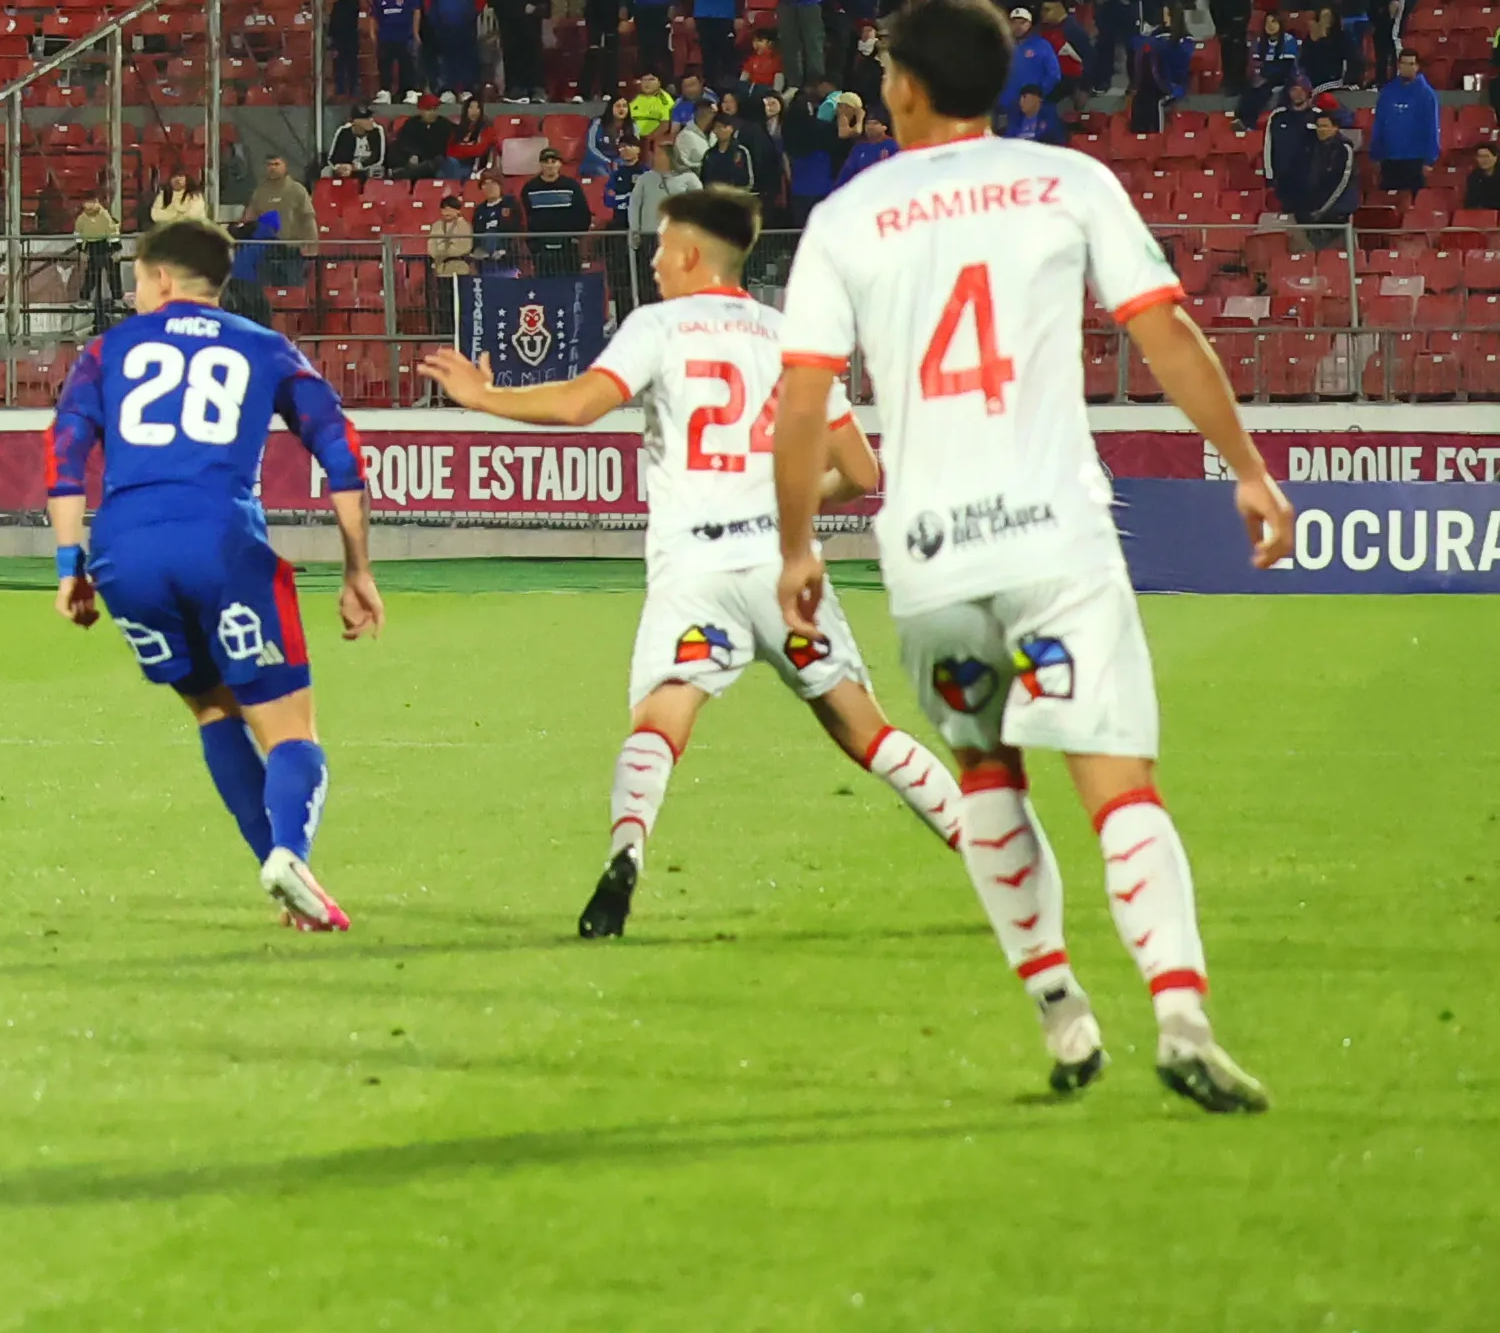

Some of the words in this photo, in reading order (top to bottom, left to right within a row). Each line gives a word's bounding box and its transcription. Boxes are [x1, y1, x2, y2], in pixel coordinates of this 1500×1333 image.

[875, 176, 1062, 238] RAMIREZ
[920, 261, 1015, 415] 4
[119, 341, 250, 446] 28
[469, 445, 622, 501] ESTADIO
